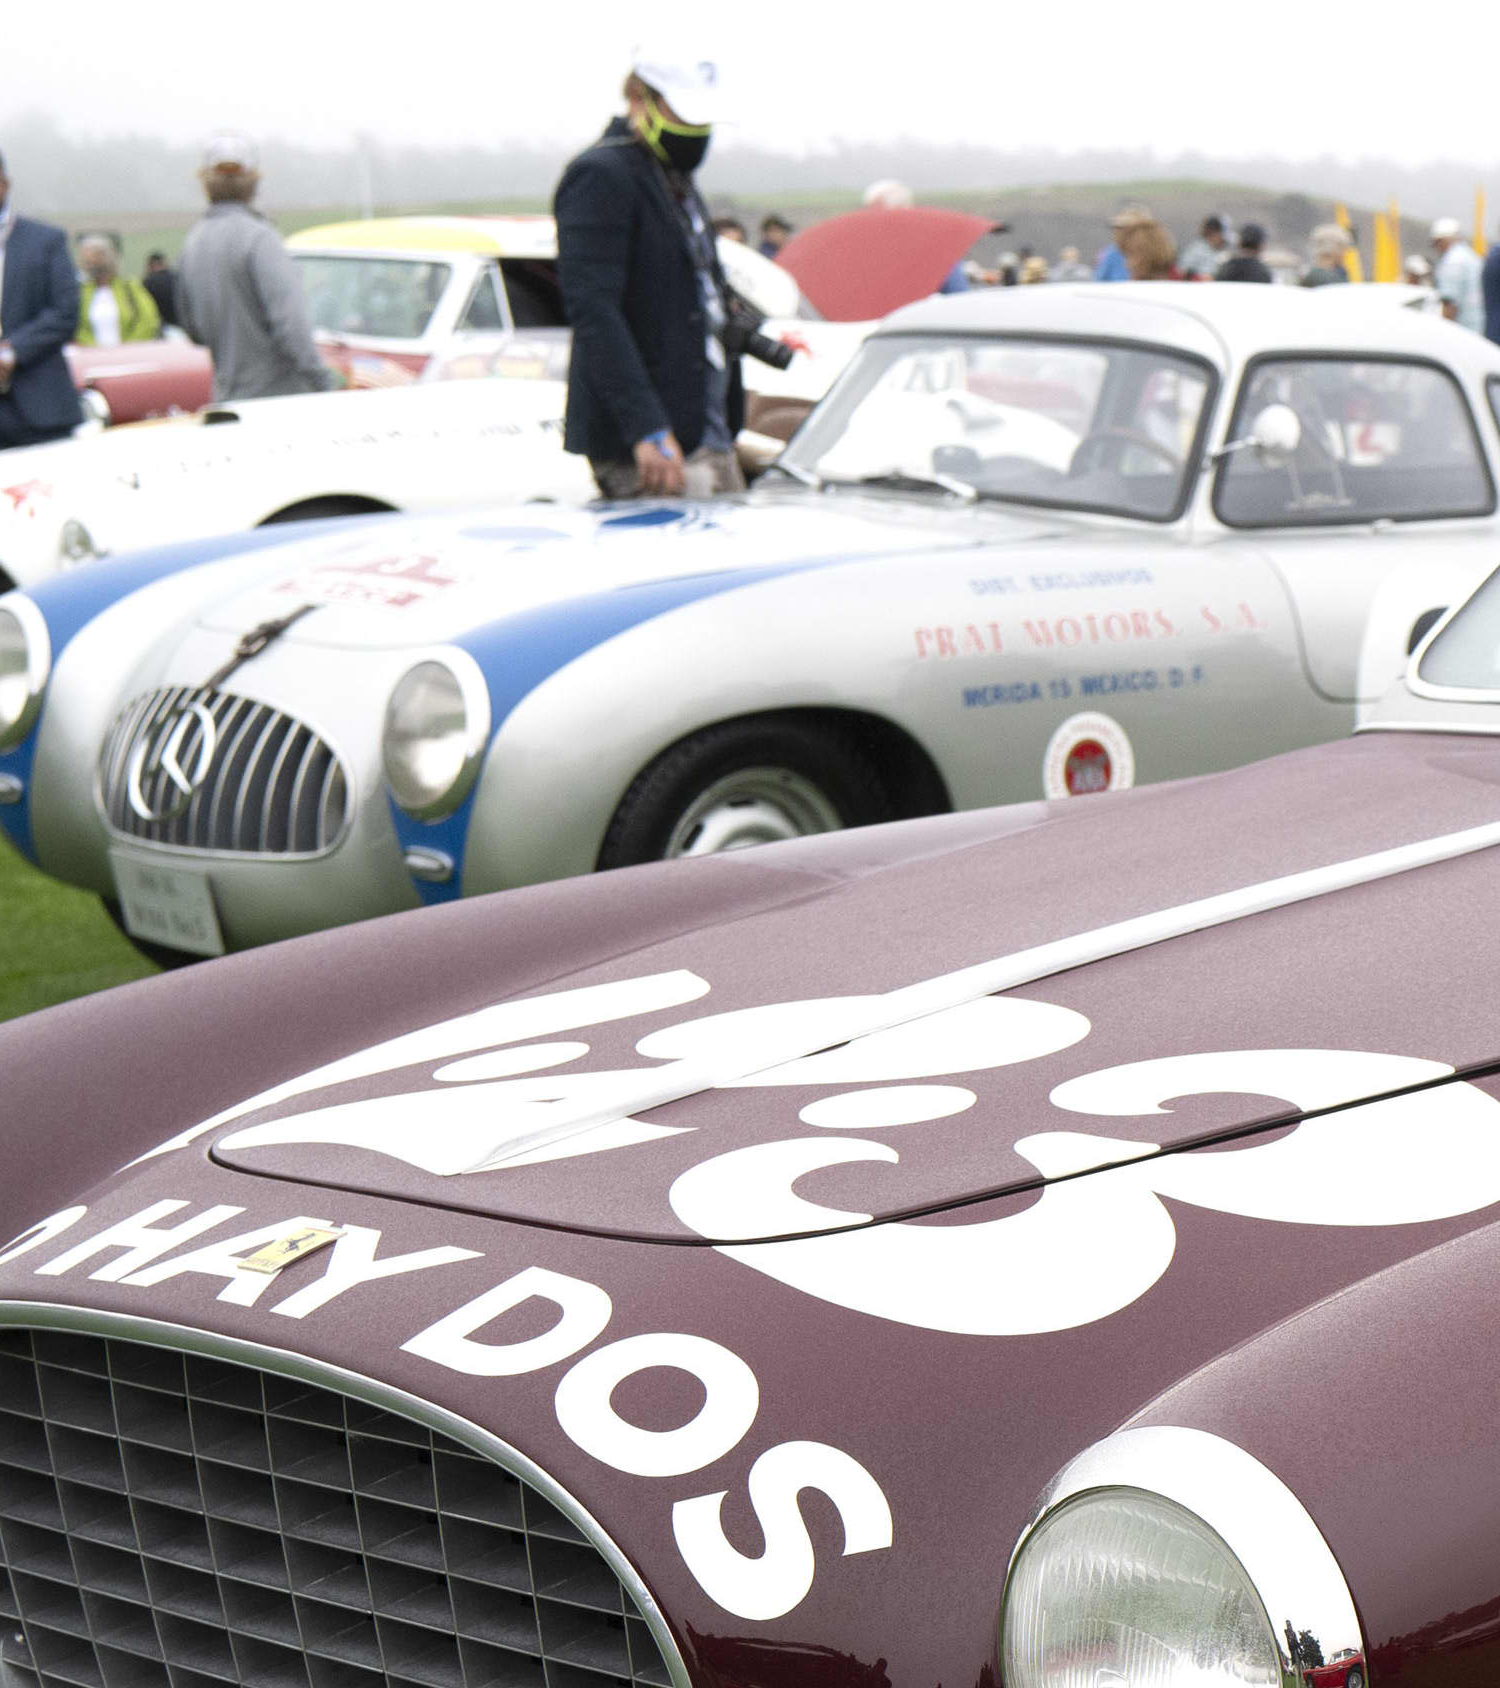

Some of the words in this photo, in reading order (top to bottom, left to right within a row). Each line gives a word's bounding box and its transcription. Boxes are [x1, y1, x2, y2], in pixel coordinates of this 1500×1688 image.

[914, 620, 1003, 659] PRAT
[963, 682, 1041, 707] MERIDA
[35, 1198, 485, 1319] HAY
[399, 1266, 894, 1621] DOS
